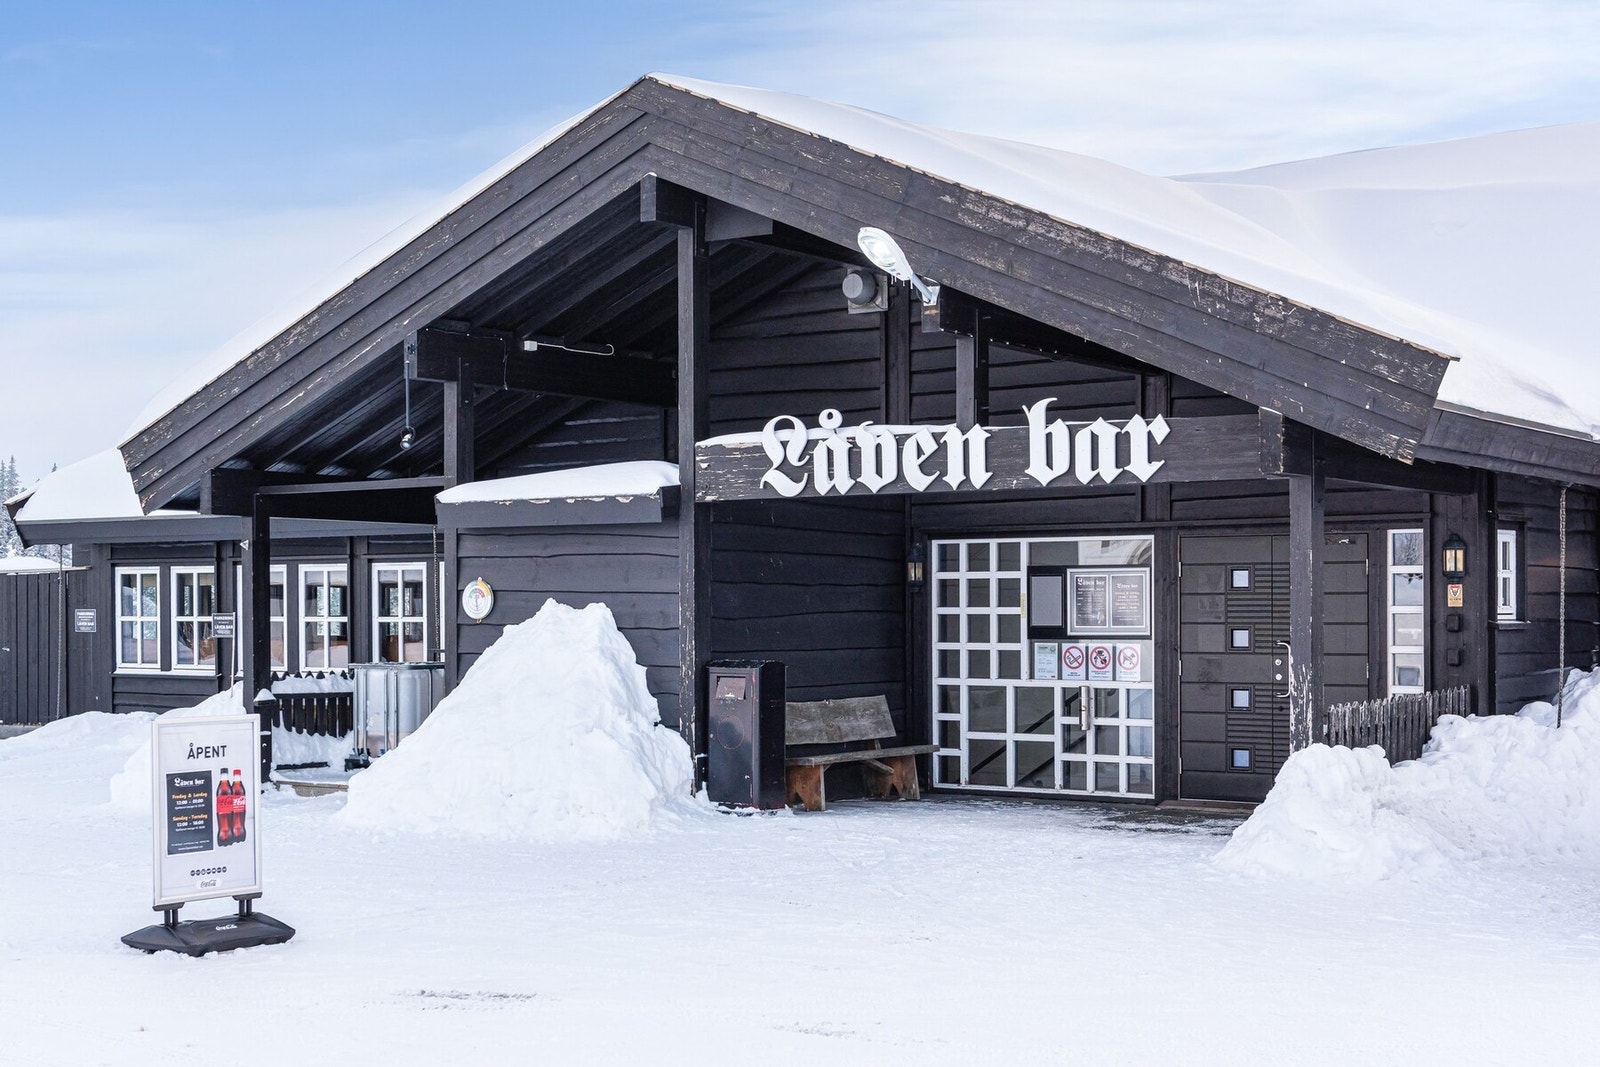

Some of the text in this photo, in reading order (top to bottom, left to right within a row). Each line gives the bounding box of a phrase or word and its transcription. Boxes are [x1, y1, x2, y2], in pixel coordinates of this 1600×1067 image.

[759, 397, 1171, 498] Låven bar
[187, 743, 227, 760] ÅPENT
[174, 777, 194, 787] Låven
